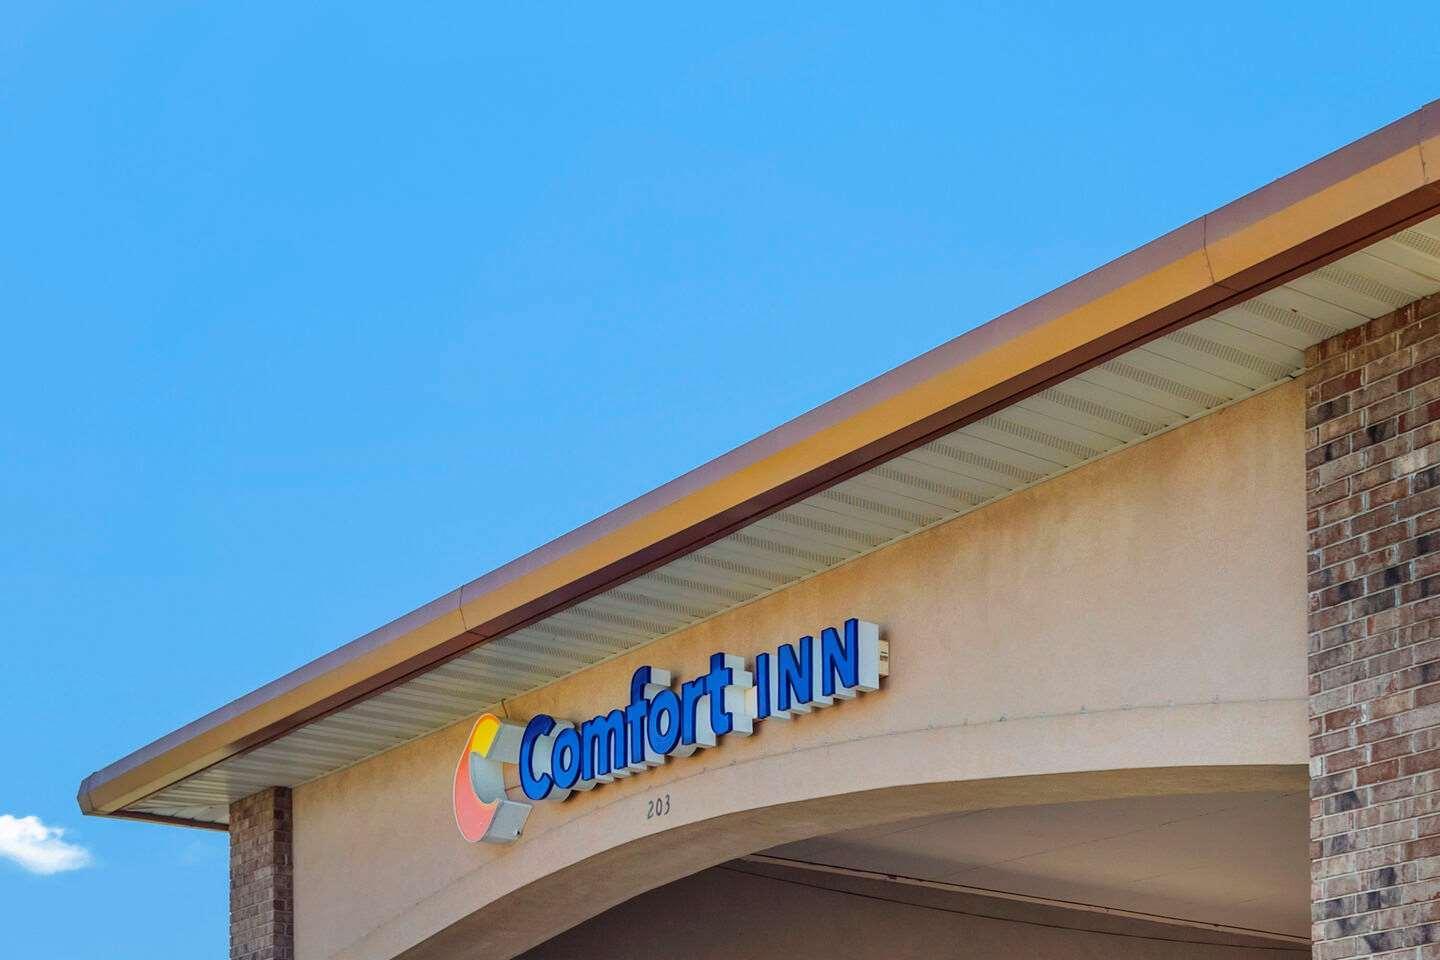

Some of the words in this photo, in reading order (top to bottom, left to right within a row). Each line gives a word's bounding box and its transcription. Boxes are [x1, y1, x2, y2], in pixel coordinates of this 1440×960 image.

[518, 652, 734, 801] Comfort
[756, 617, 860, 720] INN
[647, 794, 671, 819] 203
